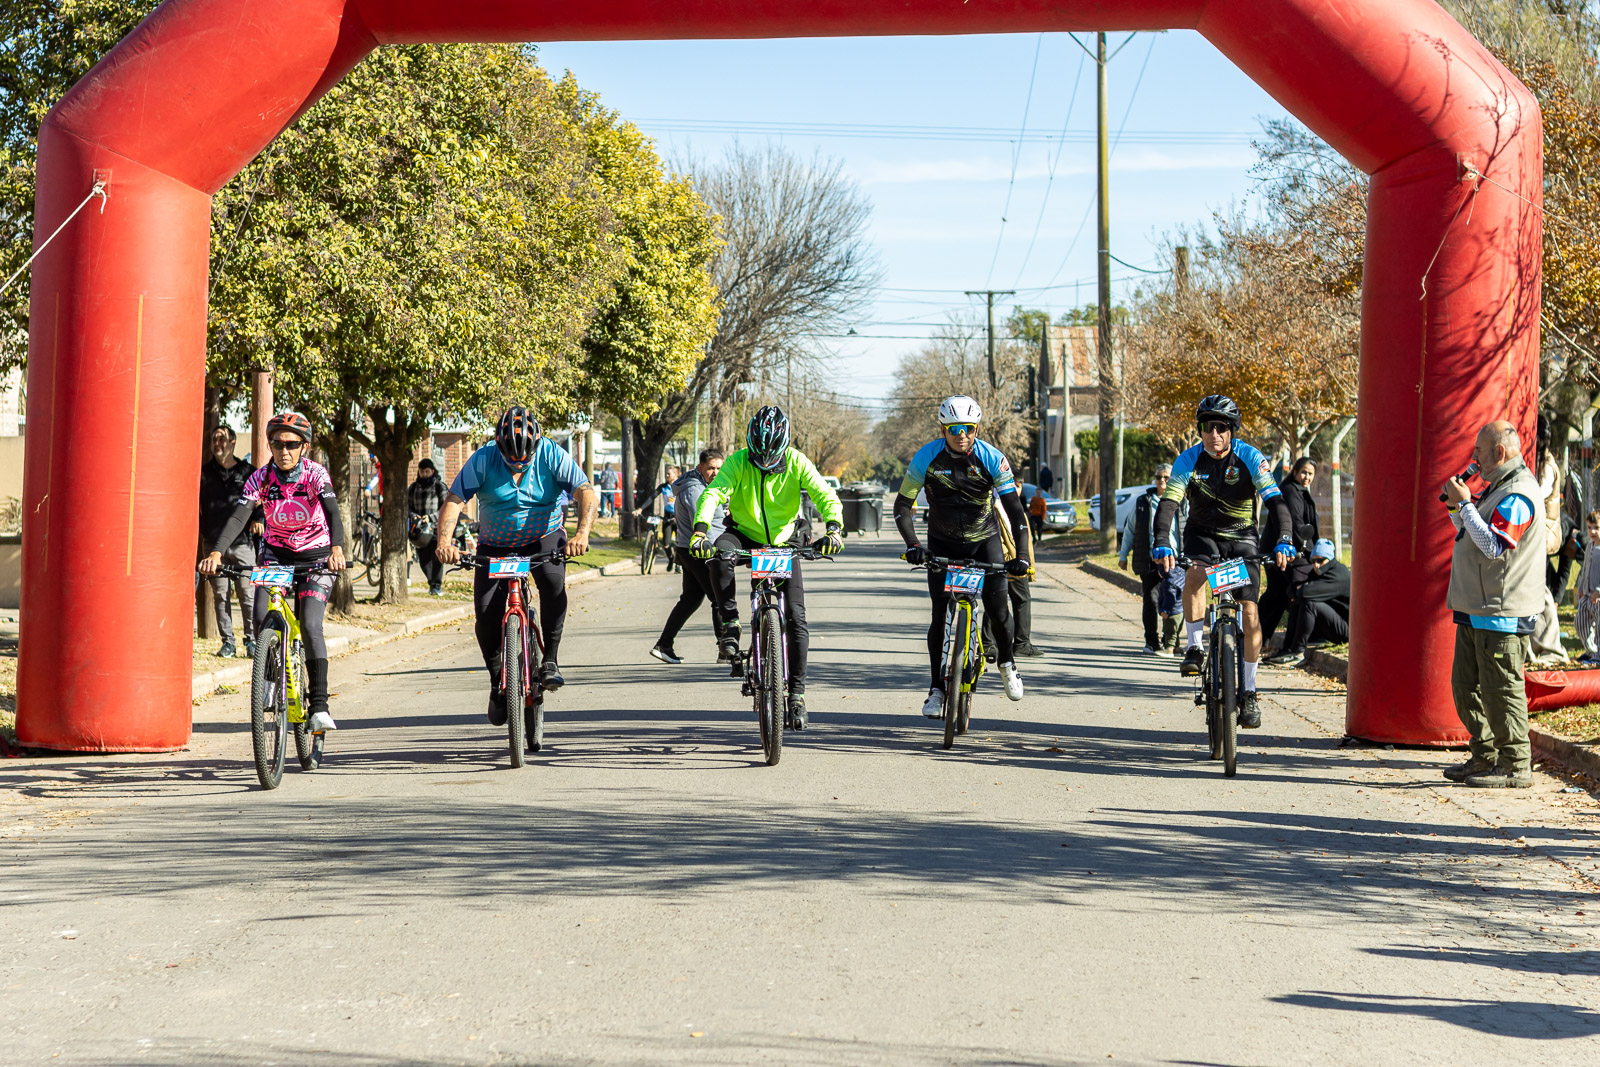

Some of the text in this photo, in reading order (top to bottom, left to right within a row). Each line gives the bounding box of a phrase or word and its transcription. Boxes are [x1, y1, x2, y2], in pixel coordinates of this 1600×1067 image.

[278, 512, 288, 522] B
[295, 511, 306, 521] B
[499, 562, 519, 572] 10
[255, 571, 291, 583] 173
[951, 573, 981, 588] 178
[1215, 566, 1240, 586] 62
